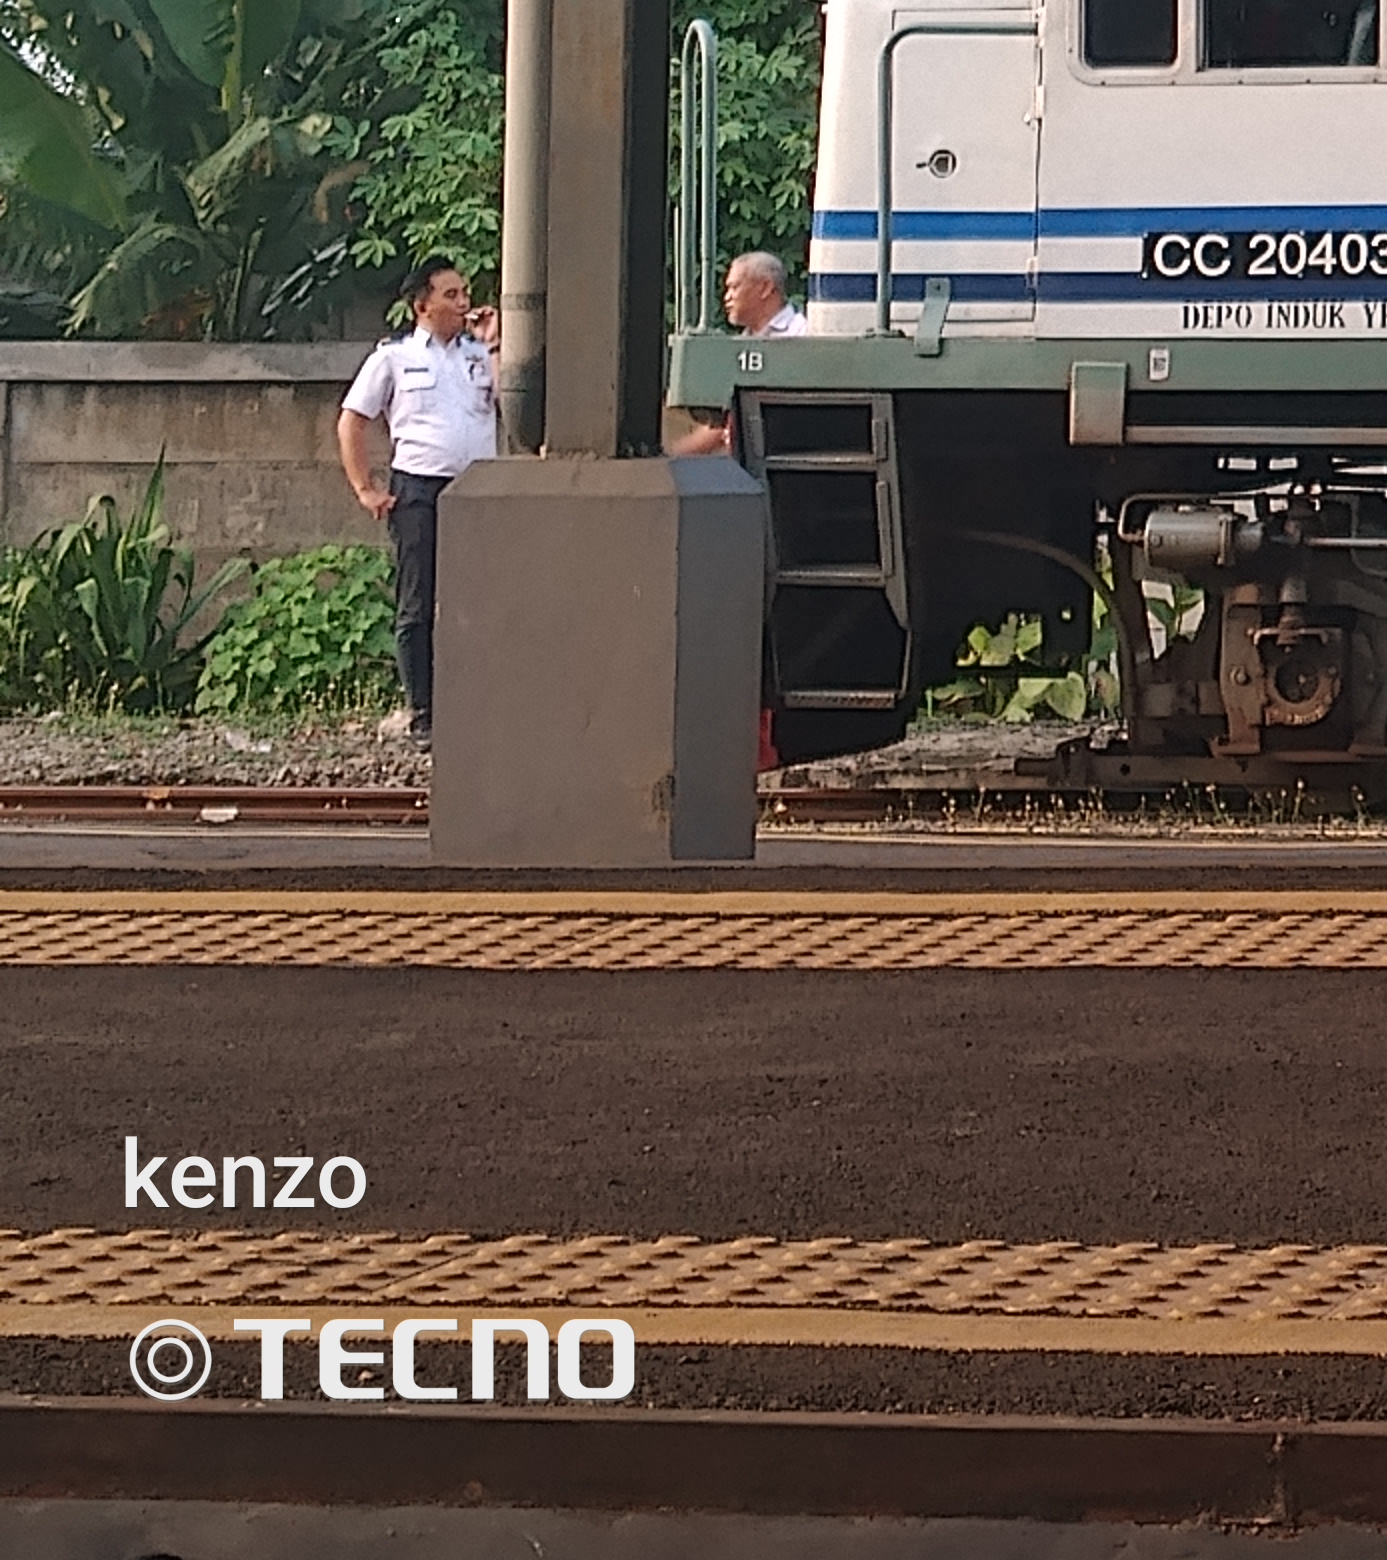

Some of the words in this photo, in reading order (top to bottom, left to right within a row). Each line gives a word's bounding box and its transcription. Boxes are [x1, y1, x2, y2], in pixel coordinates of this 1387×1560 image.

[1153, 234, 1230, 277] CC
[1182, 301, 1252, 329] DEPO
[1265, 301, 1346, 329] INDUK
[738, 351, 763, 371] 1B
